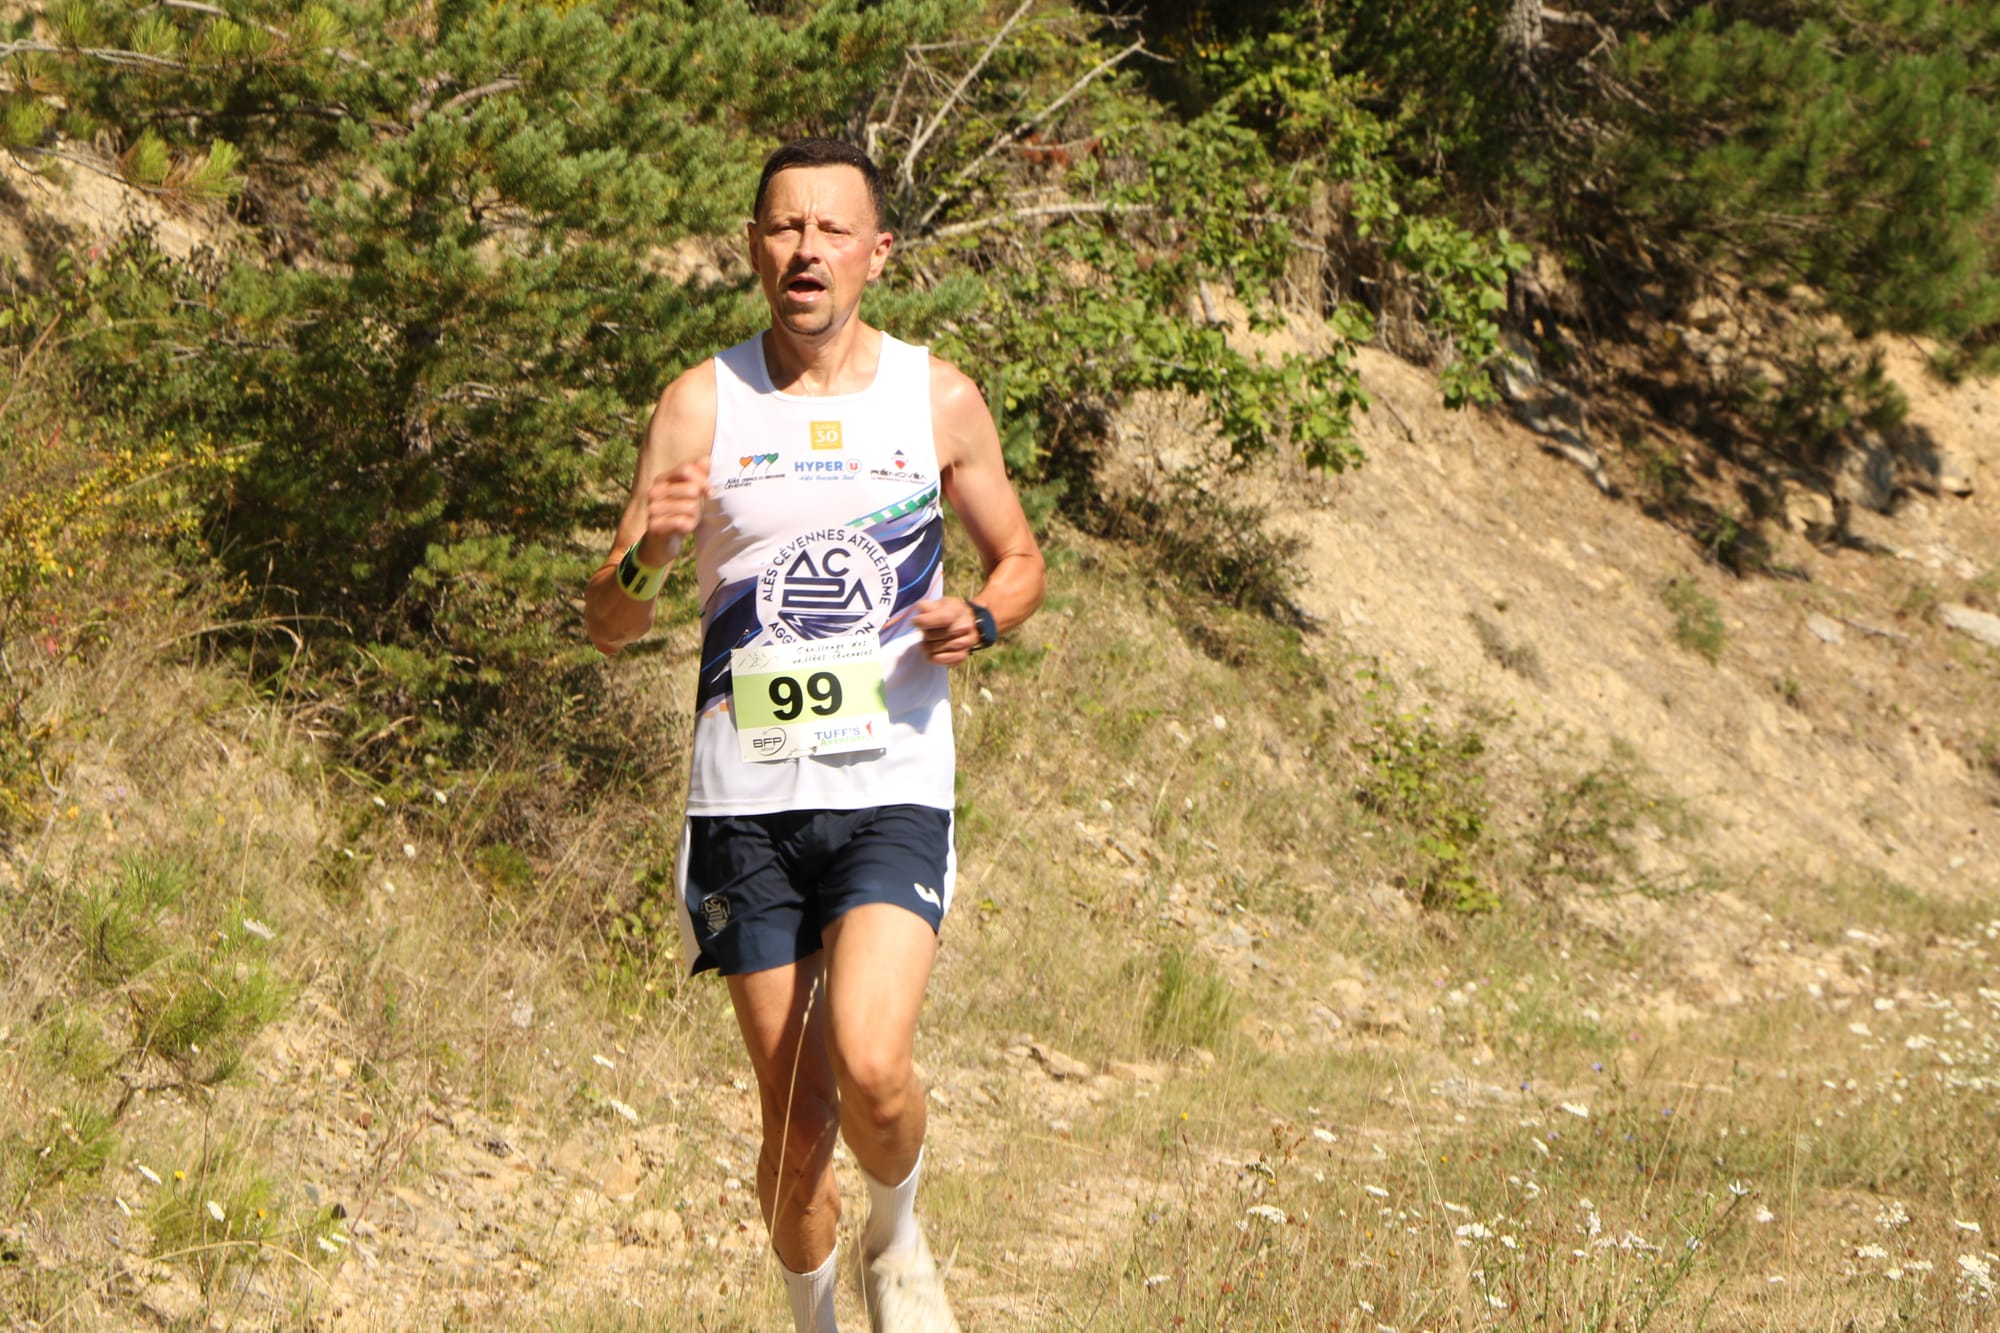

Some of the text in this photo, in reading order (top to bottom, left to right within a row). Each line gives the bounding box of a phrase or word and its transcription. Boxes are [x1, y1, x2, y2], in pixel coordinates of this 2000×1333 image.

[815, 430, 838, 443] 30
[794, 461, 859, 472] HYPER U
[761, 528, 894, 606] ALÈS CÉVENNES ATHLÉTISME
[796, 640, 867, 655] Challenge des
[768, 671, 843, 721] 99
[814, 727, 861, 740] TUFF'S
[752, 736, 782, 748] BFP
